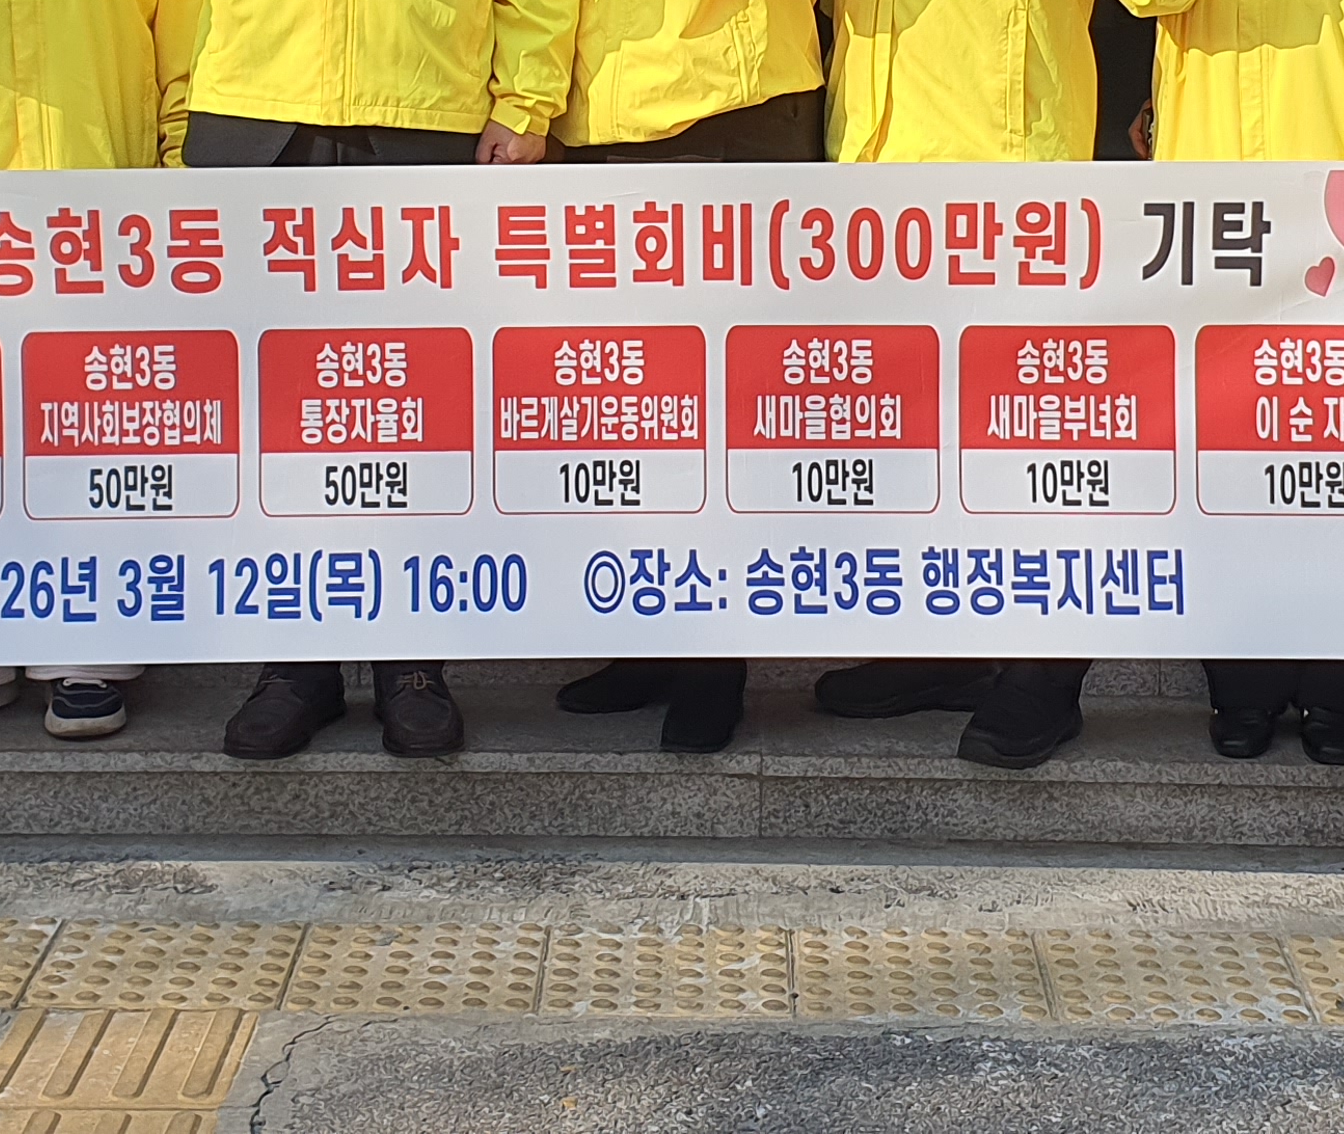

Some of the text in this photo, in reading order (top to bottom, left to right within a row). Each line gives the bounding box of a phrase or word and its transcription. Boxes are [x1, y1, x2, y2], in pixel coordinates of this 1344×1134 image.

[263, 206, 459, 292] 적십자
[495, 198, 1101, 290] 특별회비(300만원)
[1143, 202, 1271, 286] 기탁
[85, 344, 176, 390] 송현3동
[317, 342, 406, 387] 송현3동
[555, 340, 644, 385] 송현3동
[783, 338, 873, 384] 송현3동
[1017, 339, 1108, 384] 송현3동
[41, 399, 221, 446] 지역사회보장협의체
[301, 397, 422, 444] 통장자율회
[501, 395, 698, 440] 바르게살기운동위원회
[754, 394, 901, 439] 새마을협의회
[988, 394, 1136, 440] 새마을부녀회
[89, 465, 172, 511] 50만원
[325, 462, 407, 508] 50만원
[560, 460, 640, 506] 10만원
[793, 459, 873, 505] 10만원
[1027, 460, 1109, 506] 10만원
[117, 555, 184, 621] 3월
[209, 549, 381, 622] 12일(목)
[404, 554, 526, 612] 16:00
[746, 546, 902, 615] 송현3동
[922, 547, 1184, 615] 행정복지센터
